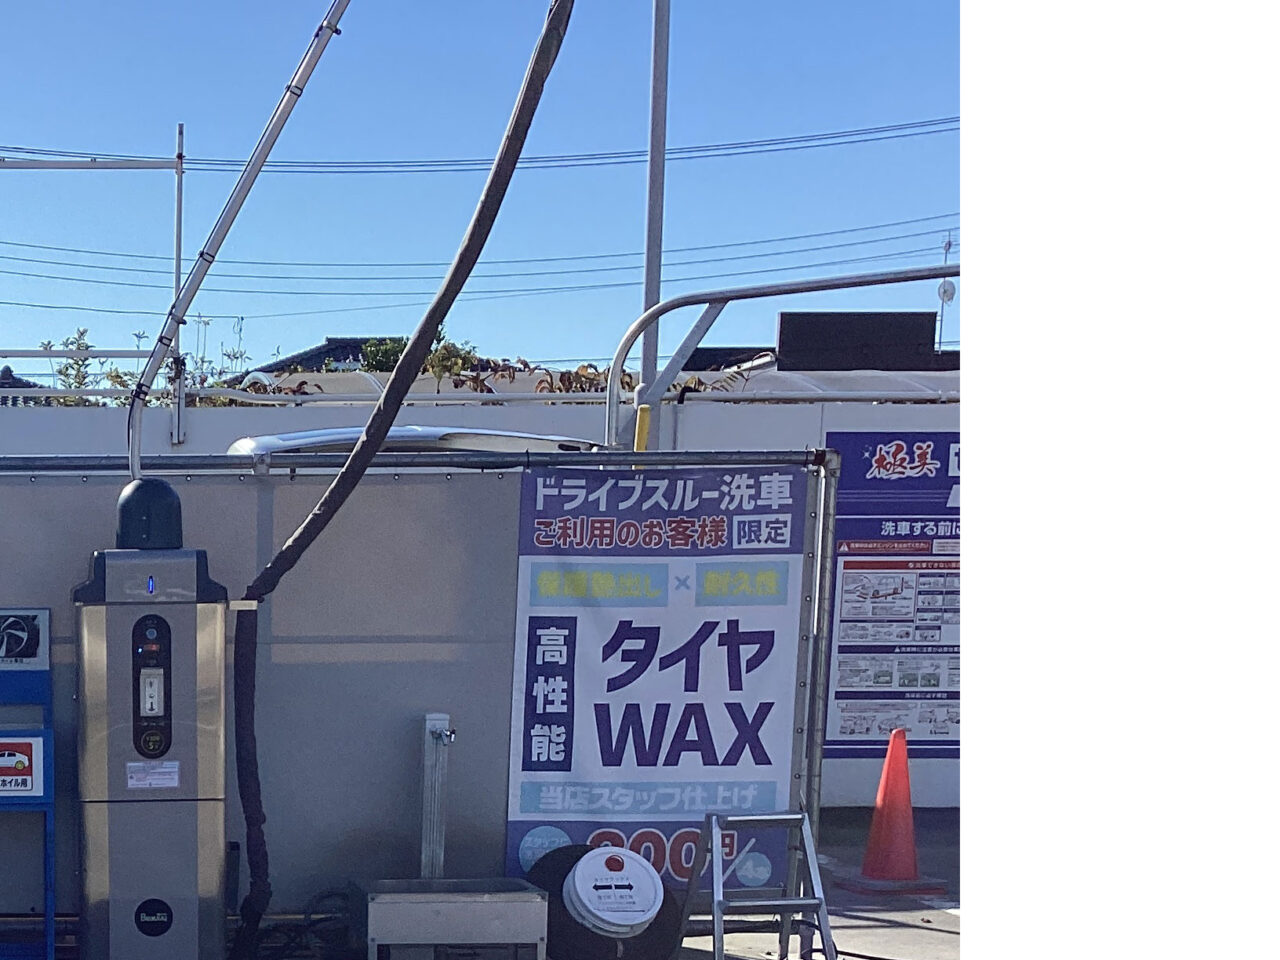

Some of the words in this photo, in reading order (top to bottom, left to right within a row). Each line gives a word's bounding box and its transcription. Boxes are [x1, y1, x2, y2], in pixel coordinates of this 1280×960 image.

[866, 440, 941, 480] 極美
[535, 472, 793, 511] ドライブスルー洗車
[534, 516, 727, 549] ご利用のお客様
[737, 519, 789, 545] 限定
[601, 619, 776, 693] タイヤ
[530, 626, 571, 763] 高性能
[593, 701, 776, 767] WAX
[539, 785, 758, 811] 当店スタッフ仕上げ
